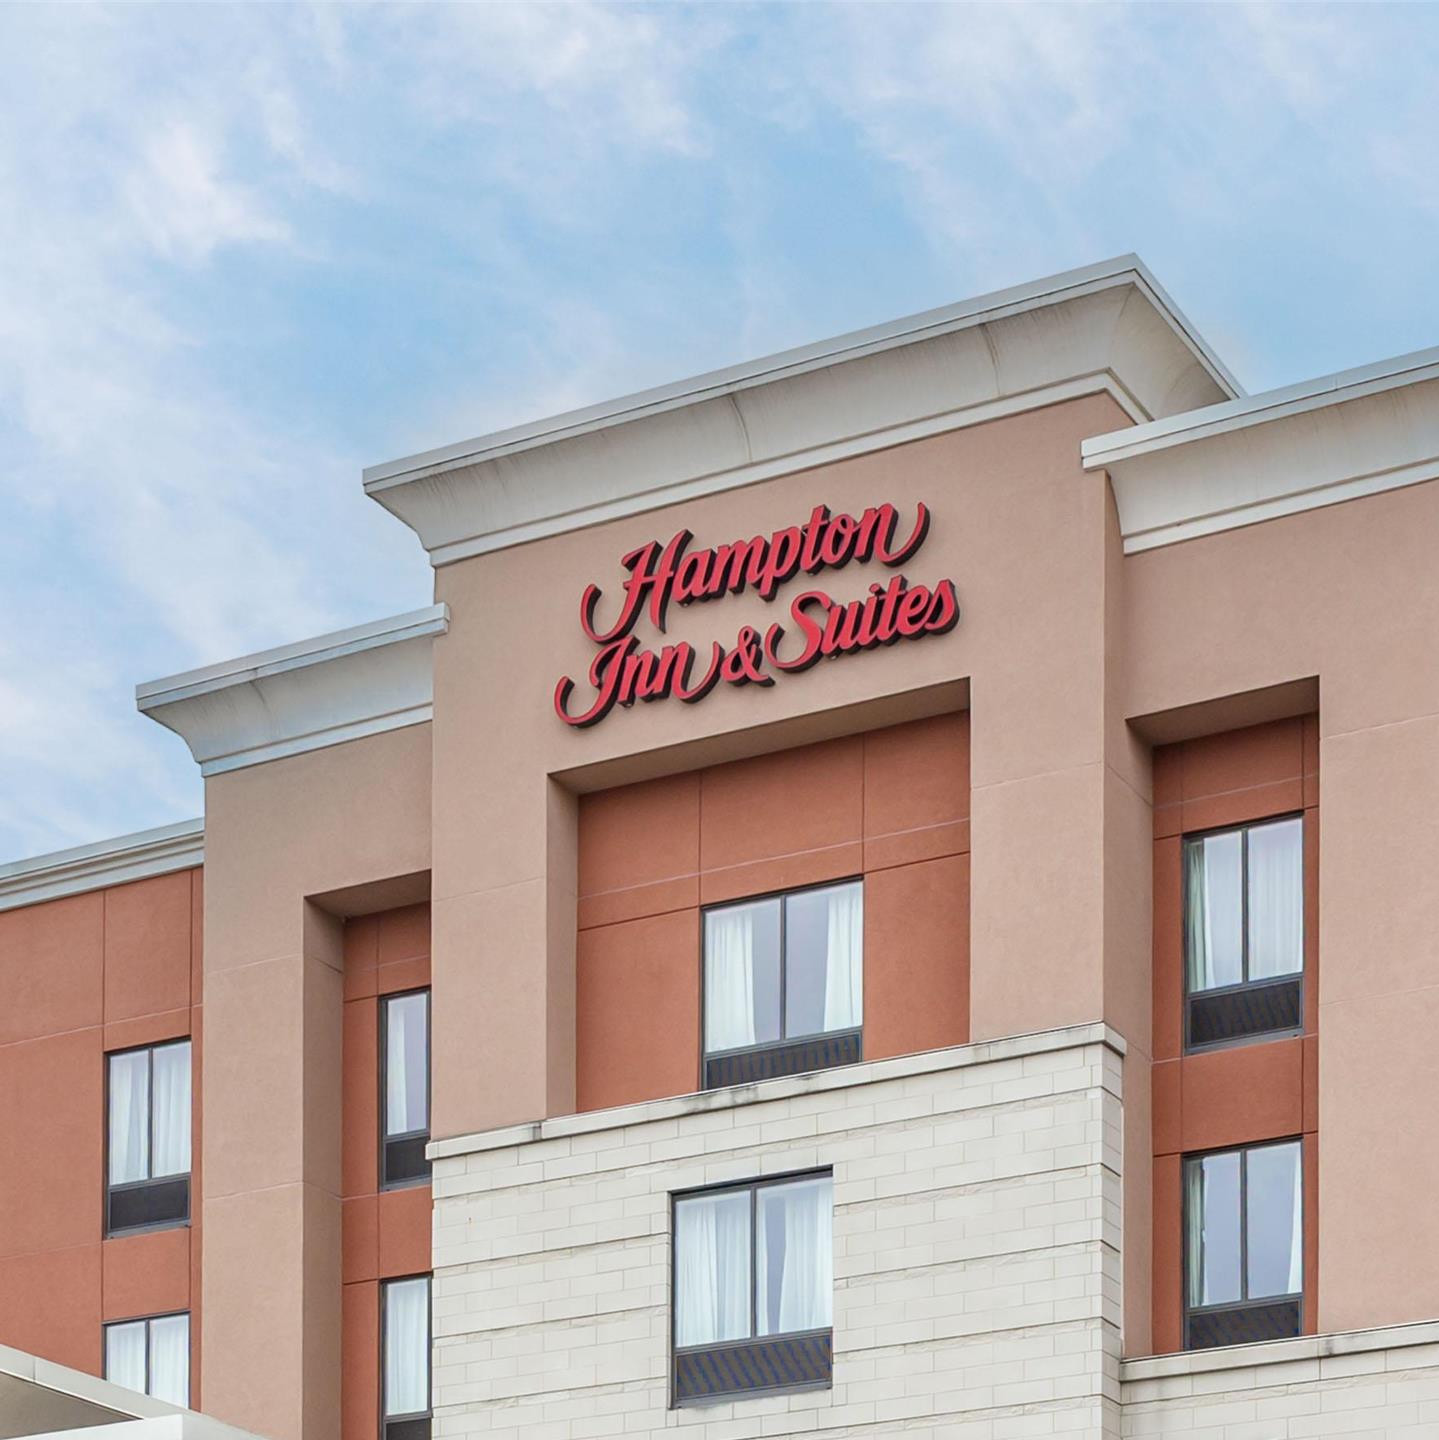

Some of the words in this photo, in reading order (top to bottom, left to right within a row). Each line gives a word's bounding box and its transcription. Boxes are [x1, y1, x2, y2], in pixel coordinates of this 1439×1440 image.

[580, 501, 931, 643] Hampton
[553, 634, 725, 729] Inn
[720, 624, 775, 687] &
[765, 573, 961, 673] Suites
